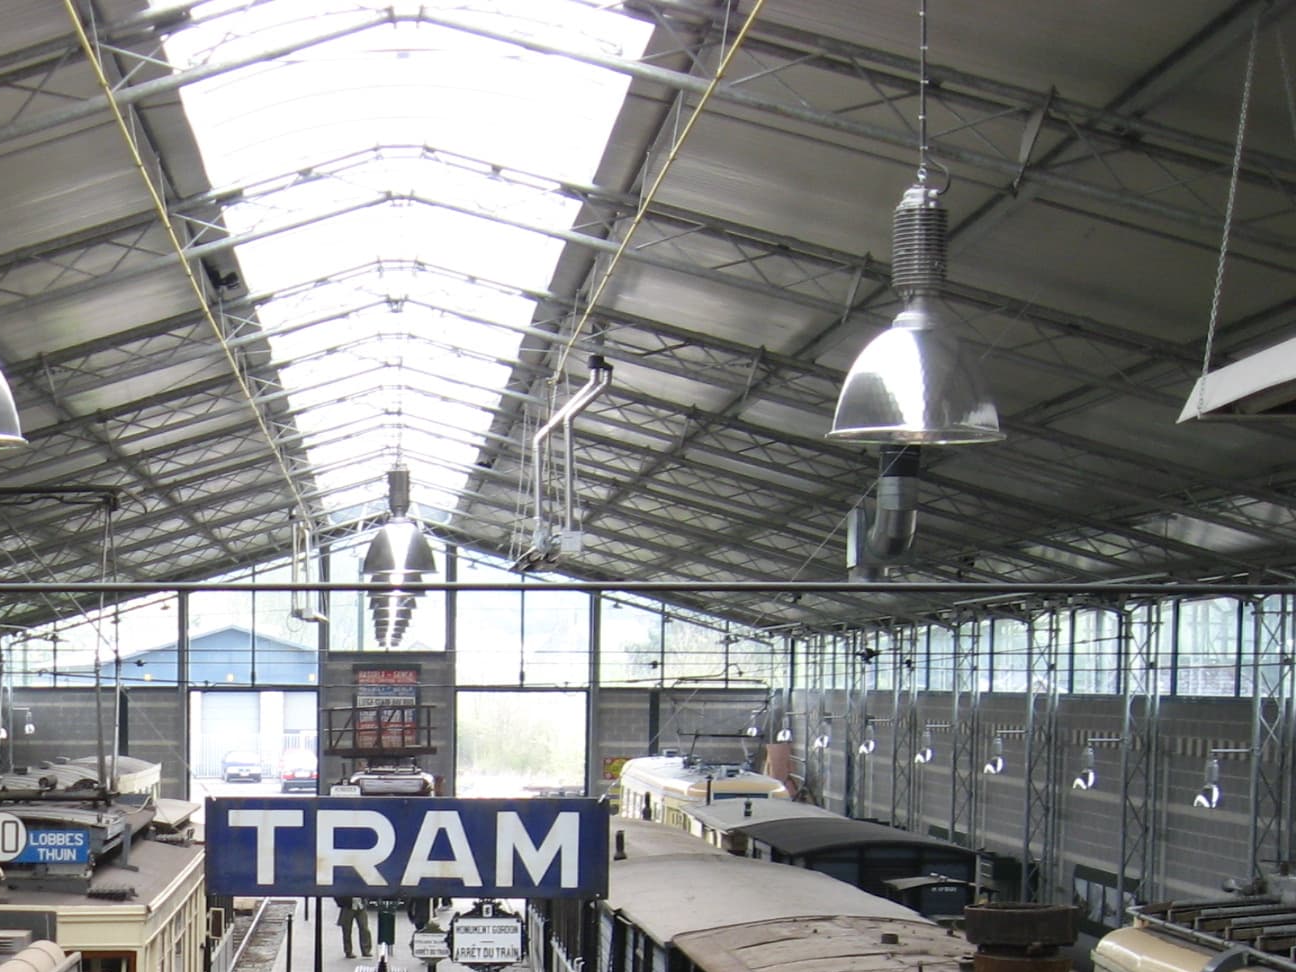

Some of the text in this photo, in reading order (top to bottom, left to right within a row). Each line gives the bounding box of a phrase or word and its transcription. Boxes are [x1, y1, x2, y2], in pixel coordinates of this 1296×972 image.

[29, 832, 84, 847] LOBBES
[37, 848, 77, 861] THUIN
[228, 809, 580, 888] TRAM
[483, 947, 494, 958] DU
